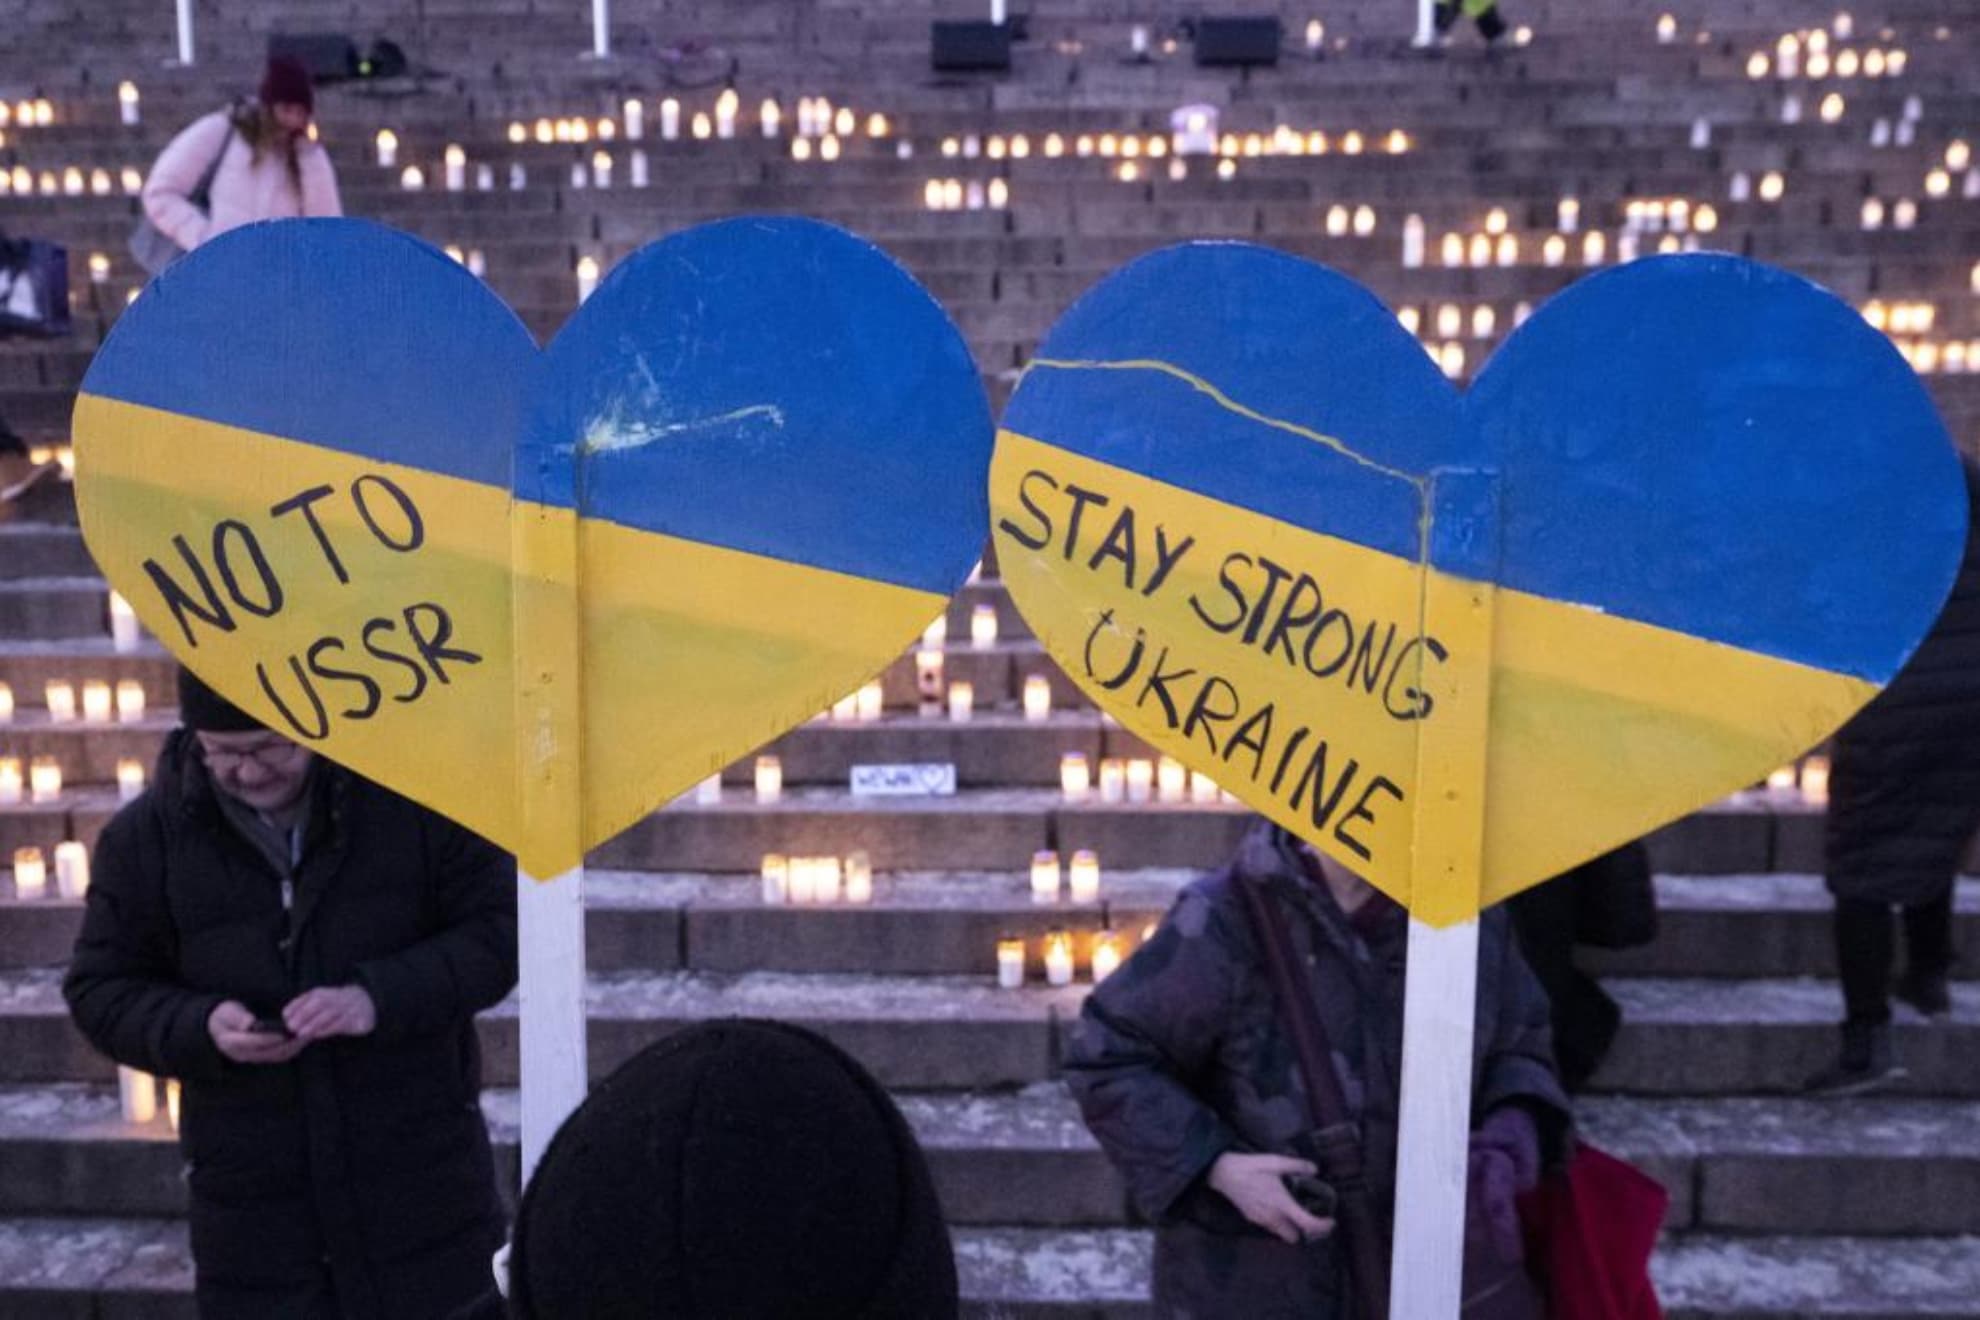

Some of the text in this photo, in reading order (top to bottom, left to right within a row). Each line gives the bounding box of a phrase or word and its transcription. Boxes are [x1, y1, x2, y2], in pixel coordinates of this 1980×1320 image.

[143, 474, 425, 647] NO TO
[1000, 470, 1448, 721] STAY STRONG
[256, 602, 483, 740] USSR
[1084, 608, 1404, 862] UKRAINE
